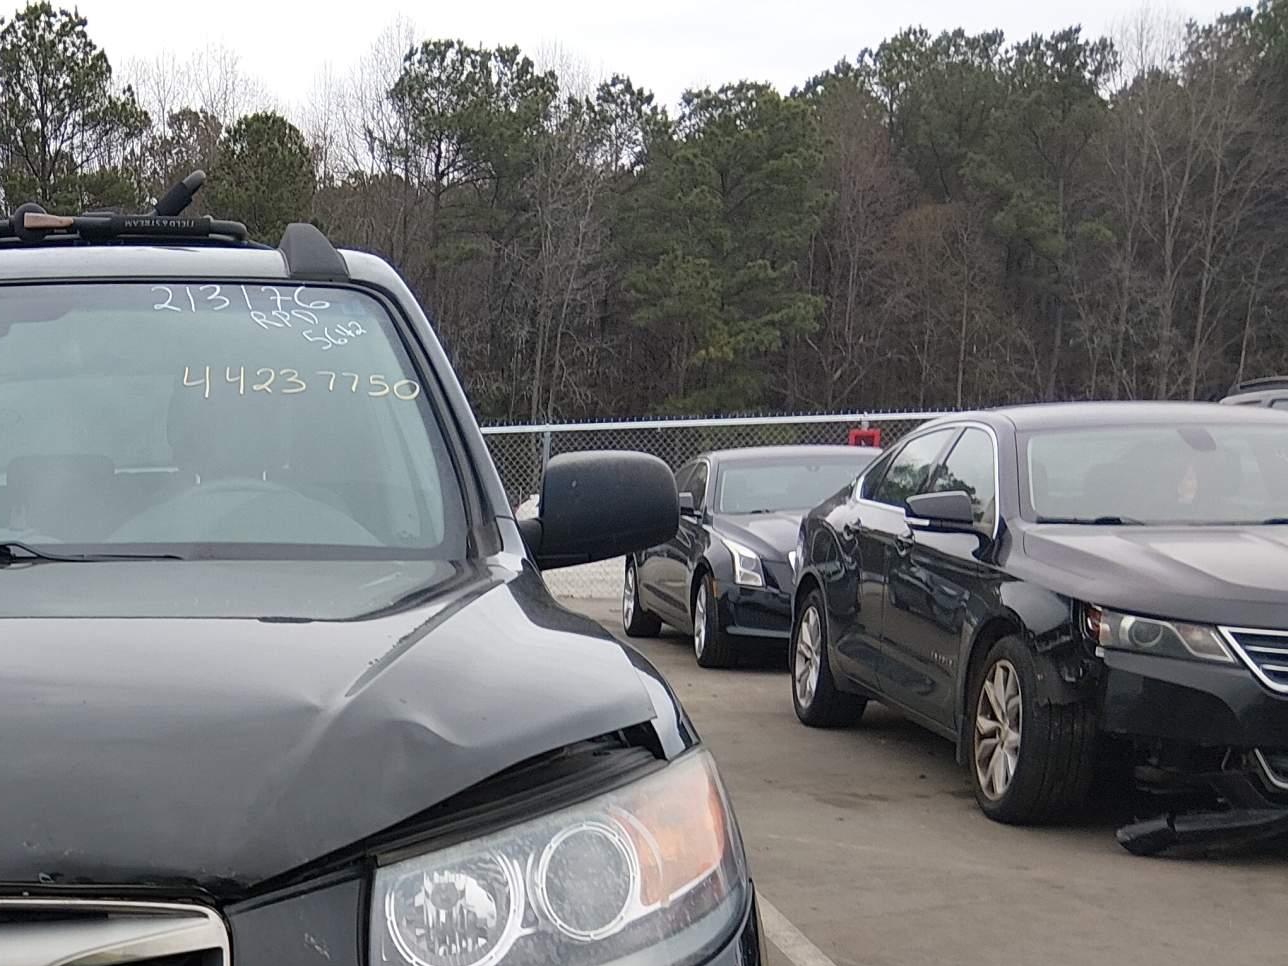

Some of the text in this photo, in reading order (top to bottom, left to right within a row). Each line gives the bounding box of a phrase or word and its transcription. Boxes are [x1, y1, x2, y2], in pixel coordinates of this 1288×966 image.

[151, 285, 331, 313] 213176
[302, 321, 367, 350] 5642
[183, 366, 420, 400] 44237750
